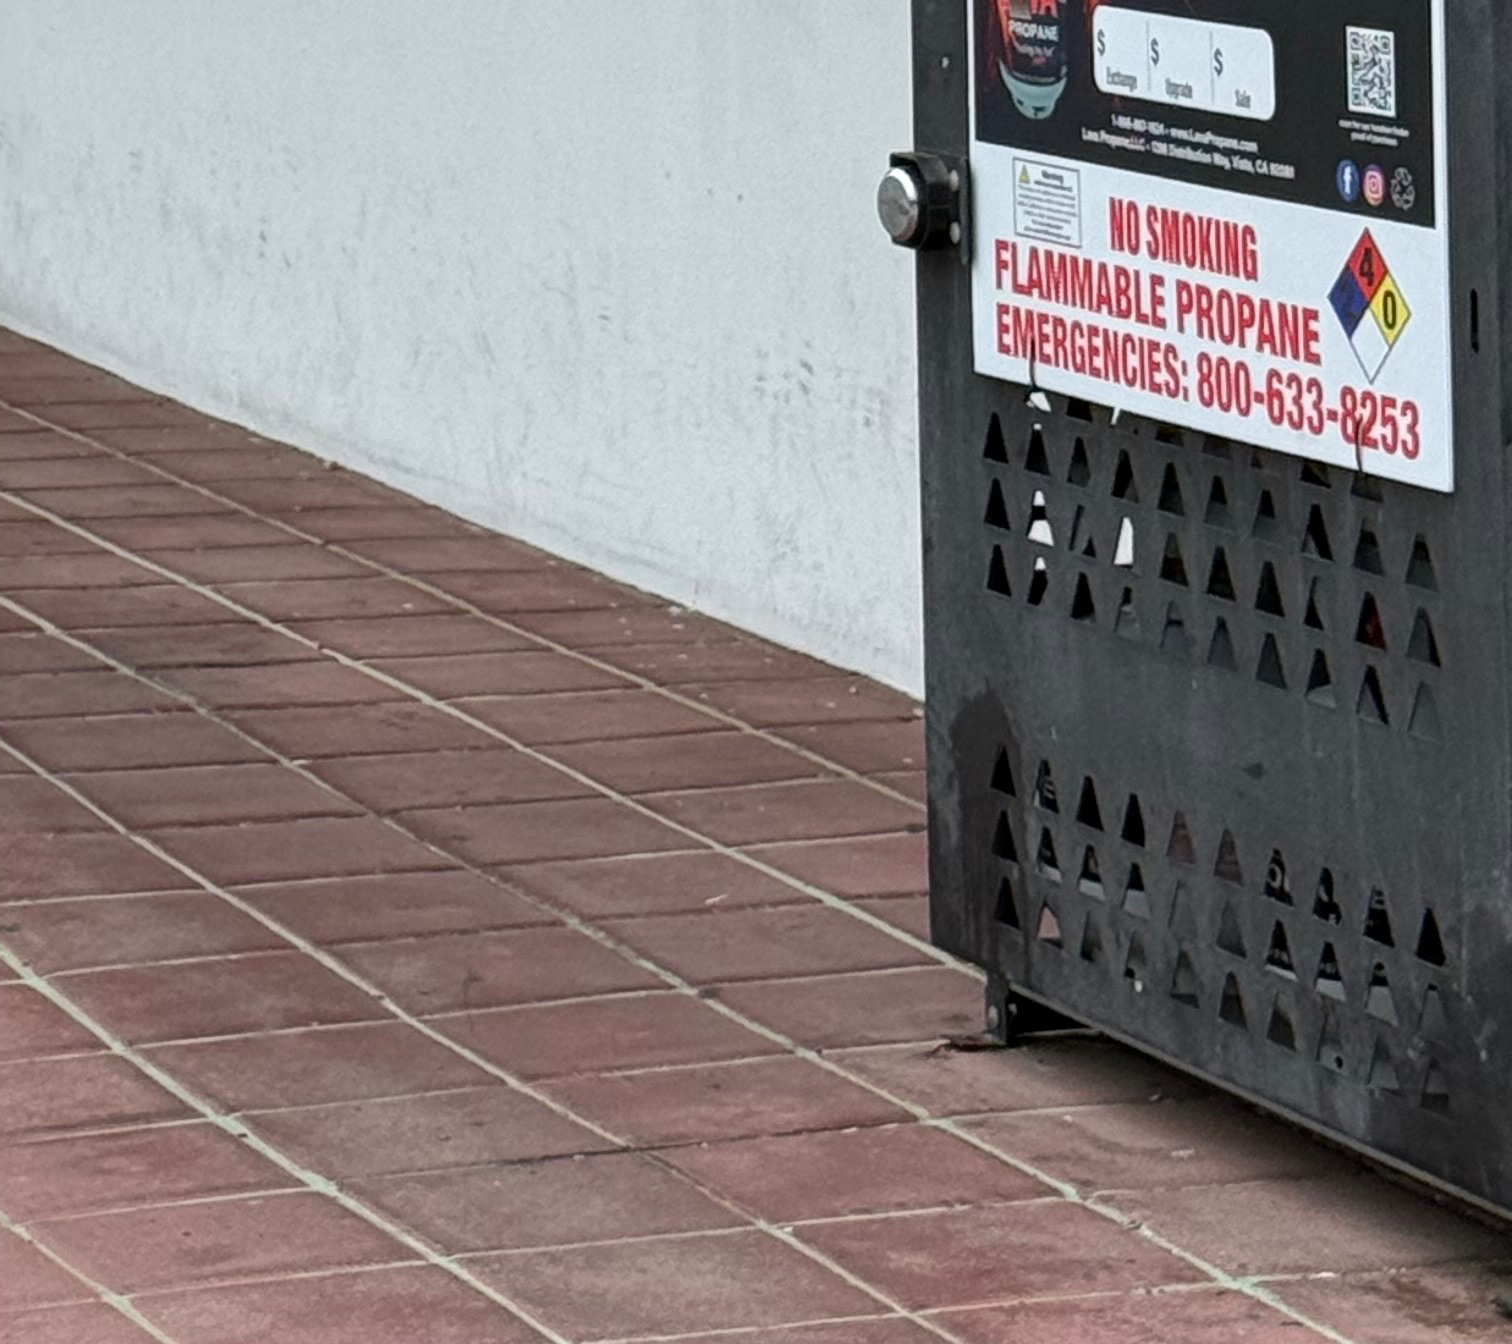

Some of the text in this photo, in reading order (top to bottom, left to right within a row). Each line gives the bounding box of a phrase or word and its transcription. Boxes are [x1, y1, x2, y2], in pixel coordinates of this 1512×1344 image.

[1108, 195, 1142, 254] NO
[1145, 204, 1259, 283] SMOKING
[1358, 246, 1374, 288] 4
[994, 237, 1167, 330] FLAMMABLE
[1175, 280, 1322, 367] PROPANE
[1382, 290, 1397, 331] 0
[995, 302, 1422, 461] EMERGENCIES: 800-633-8253
